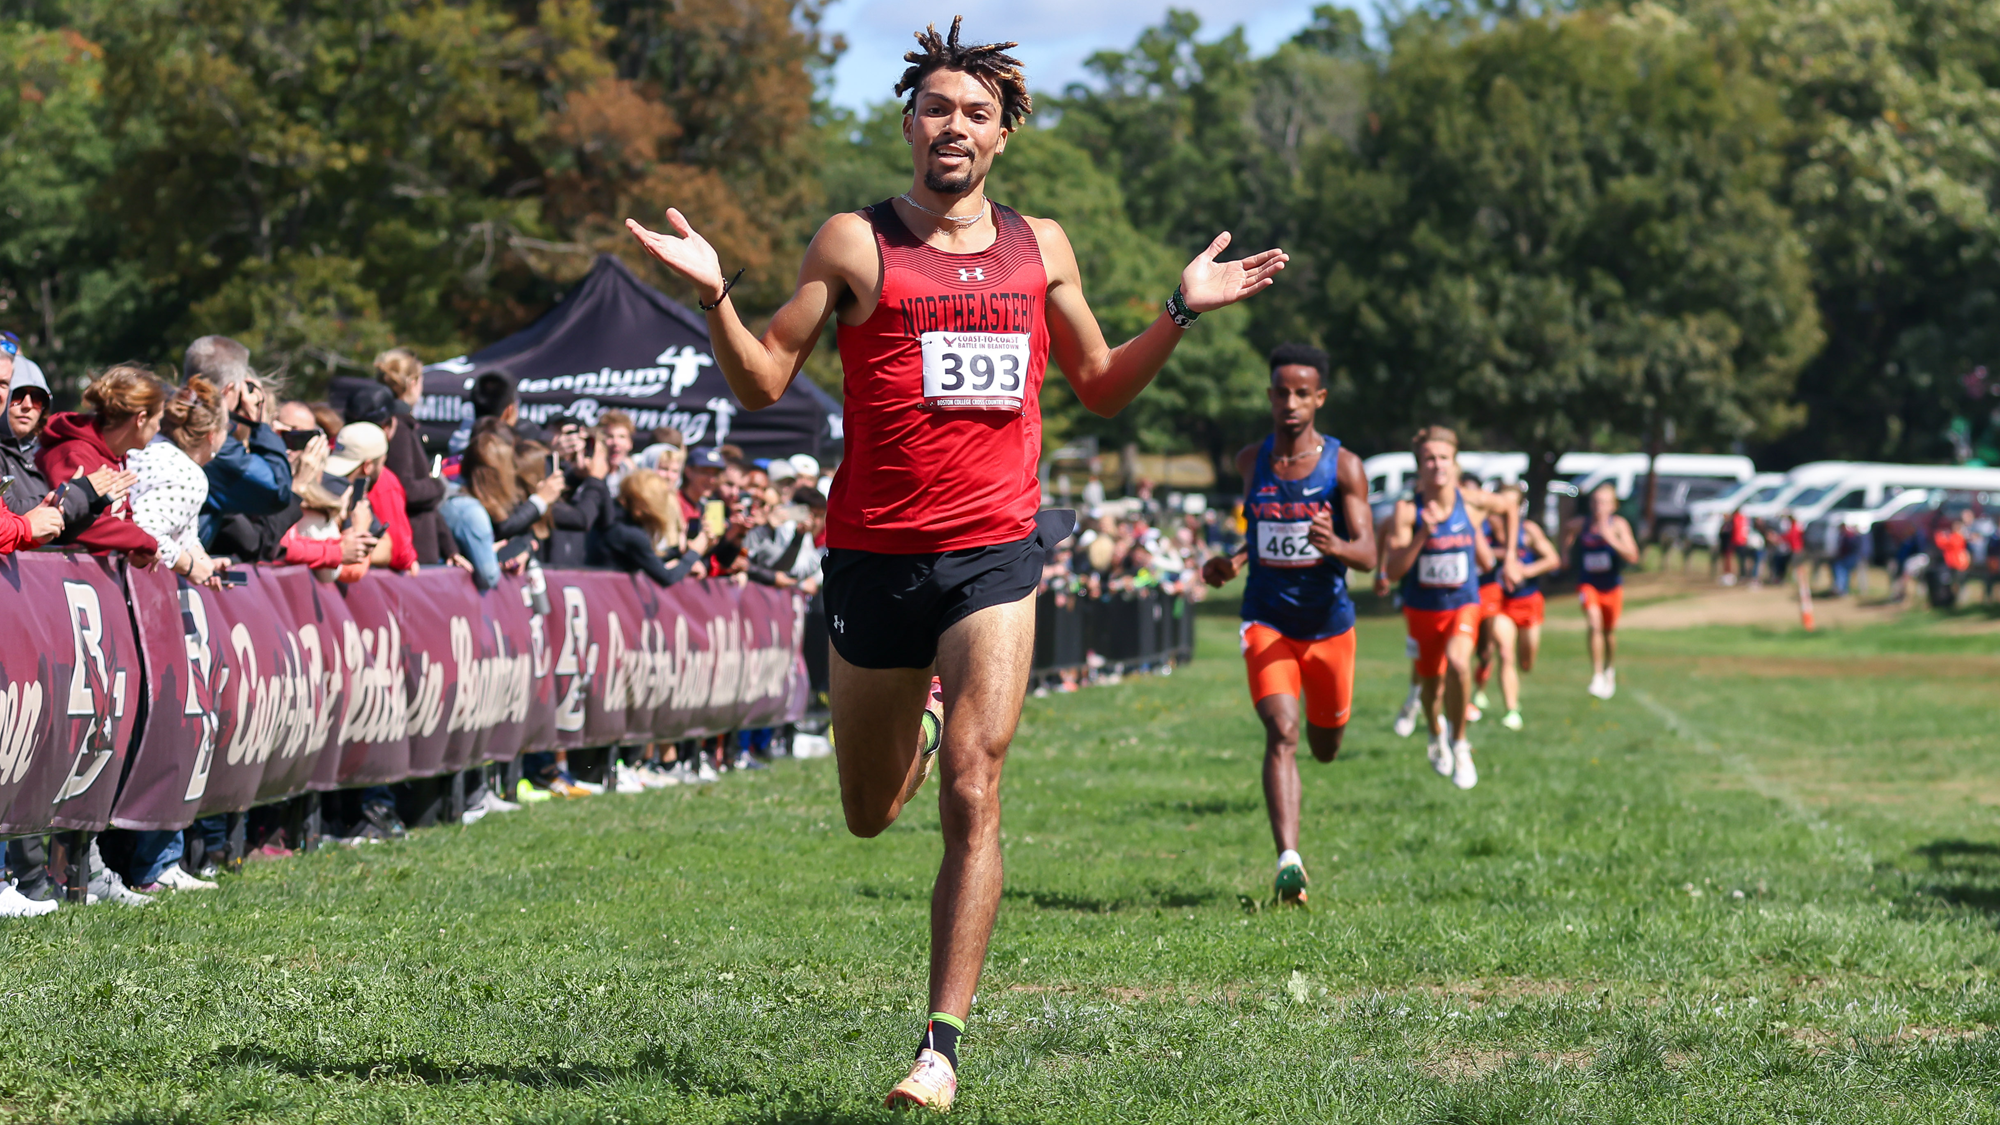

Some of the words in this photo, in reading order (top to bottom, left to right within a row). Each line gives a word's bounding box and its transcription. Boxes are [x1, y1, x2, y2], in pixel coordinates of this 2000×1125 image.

[900, 292, 1036, 337] NORTHEASTERN
[957, 335, 1019, 344] COAST-TO-COAST
[941, 352, 1020, 392] 393
[564, 397, 712, 446] Rnning
[1265, 536, 1312, 557] 462
